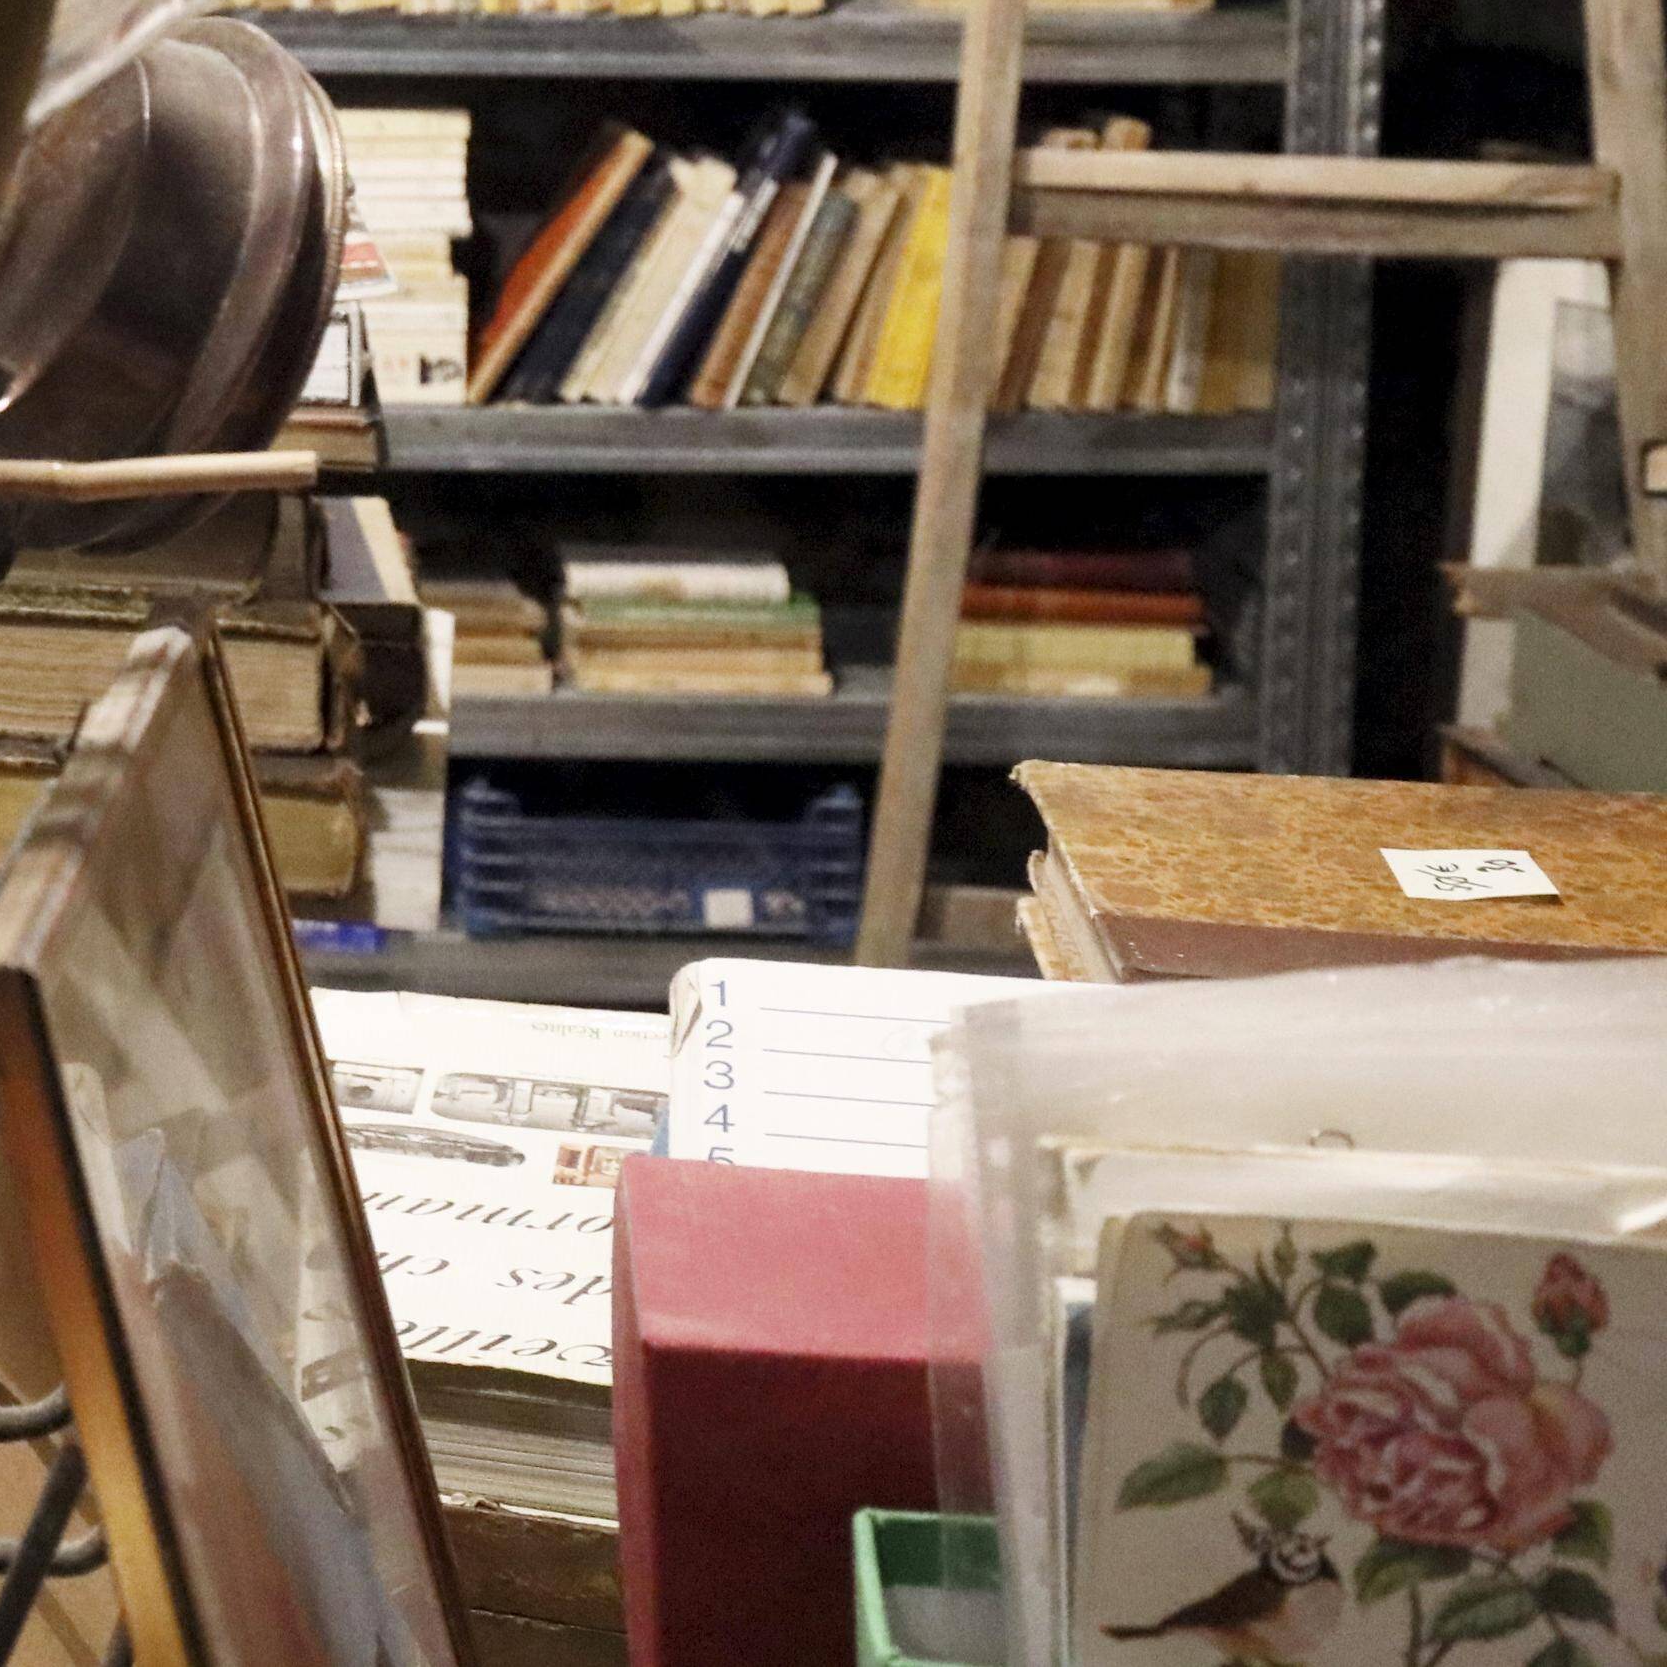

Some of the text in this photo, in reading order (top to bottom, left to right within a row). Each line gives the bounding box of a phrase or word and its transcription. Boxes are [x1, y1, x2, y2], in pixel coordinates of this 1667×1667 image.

[710, 980, 727, 1007] 1
[706, 1020, 734, 1050] 2
[703, 1060, 735, 1091] 3
[704, 1103, 736, 1134] 4
